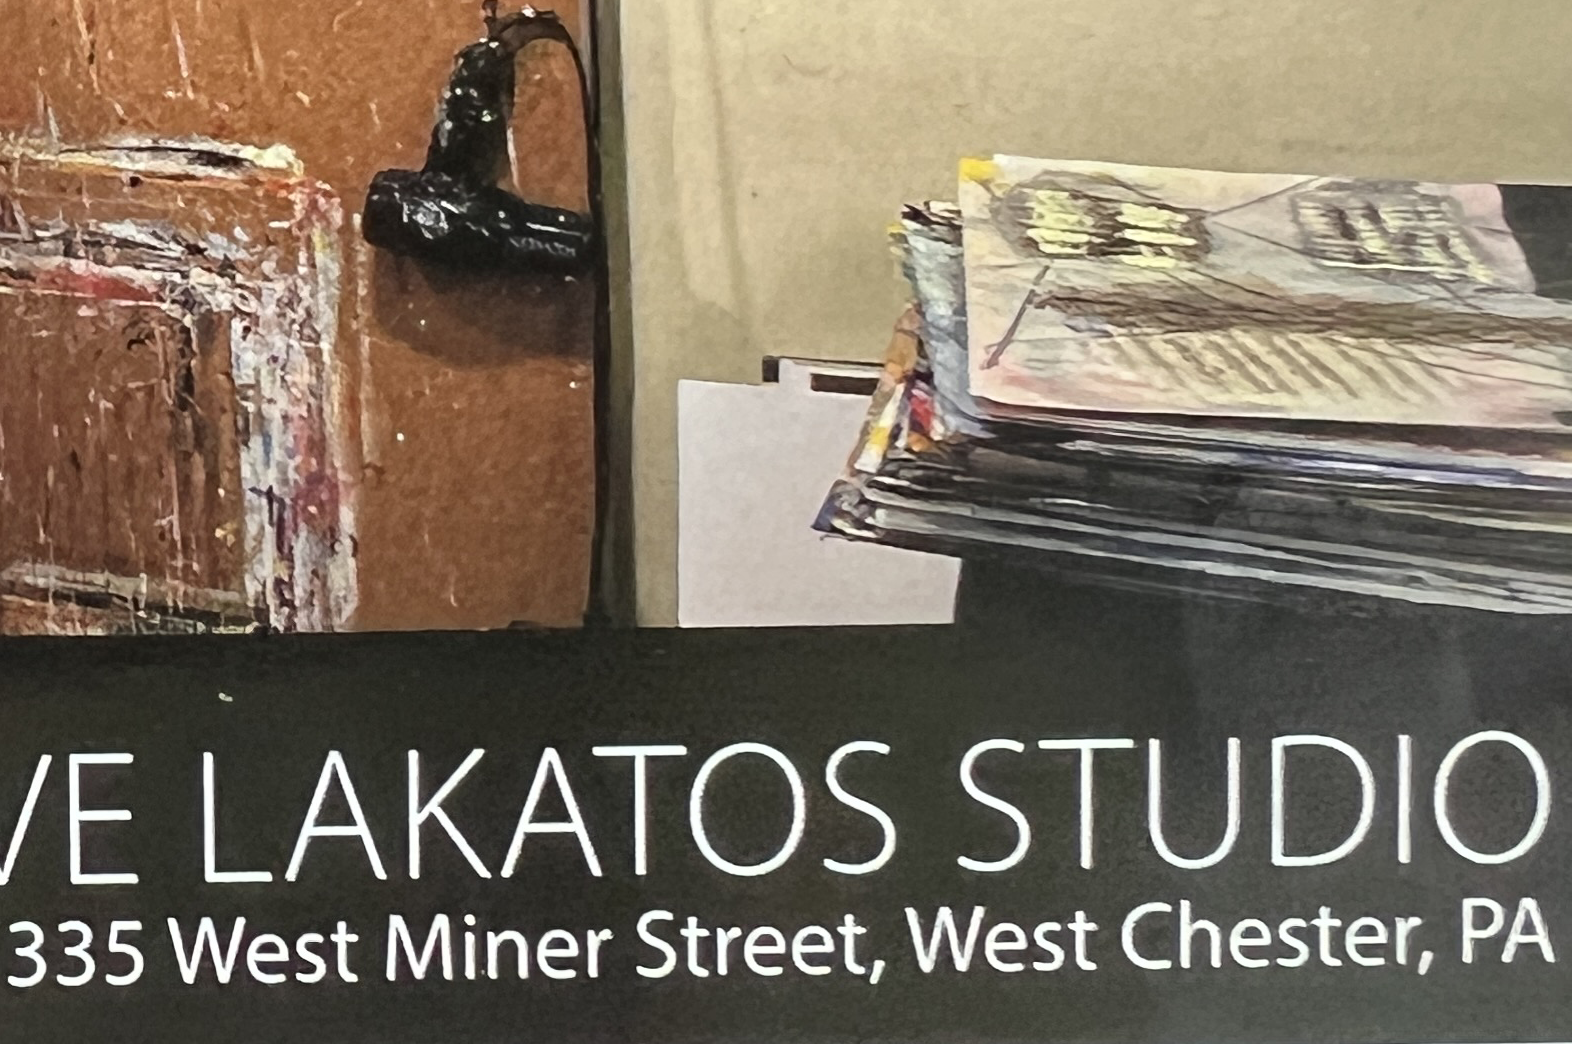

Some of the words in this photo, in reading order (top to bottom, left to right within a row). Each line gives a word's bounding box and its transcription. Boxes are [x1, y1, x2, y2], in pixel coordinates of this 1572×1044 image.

[201, 739, 898, 884] LAKATOS
[955, 728, 1554, 873] STUDIO
[6, 918, 146, 989] 335
[165, 915, 361, 986] West
[384, 911, 615, 983] Miner
[634, 908, 887, 986] Street,
[903, 904, 1100, 975] West
[1120, 897, 1436, 977] Chester,
[1460, 895, 1558, 966] PA
